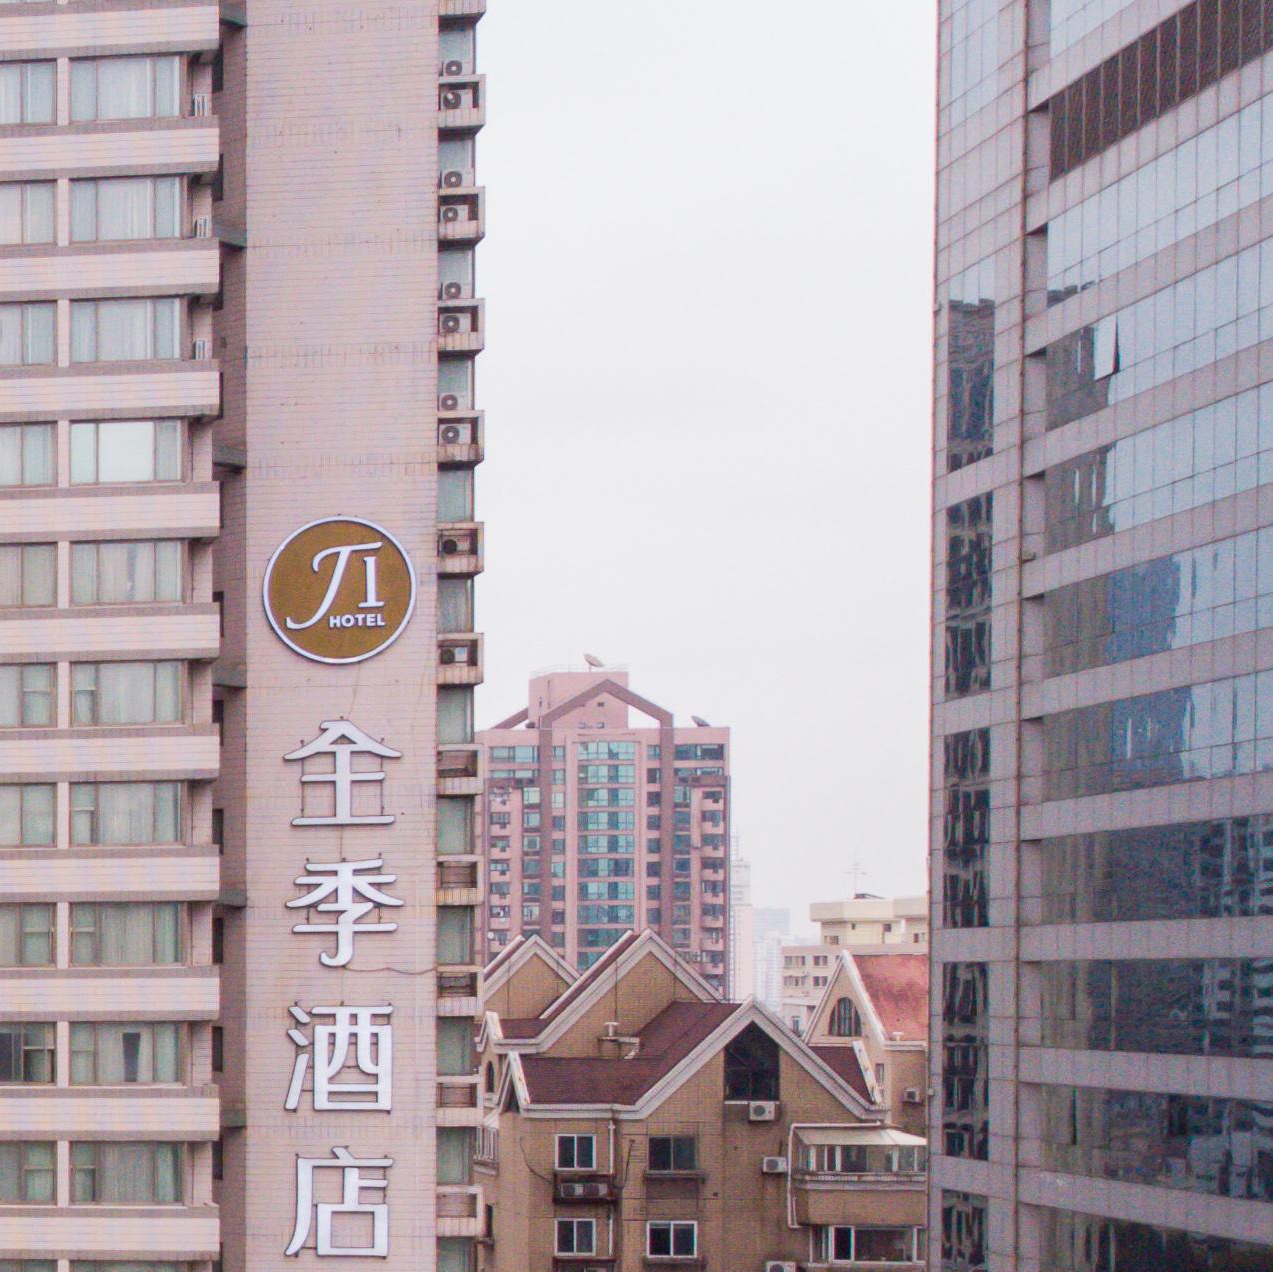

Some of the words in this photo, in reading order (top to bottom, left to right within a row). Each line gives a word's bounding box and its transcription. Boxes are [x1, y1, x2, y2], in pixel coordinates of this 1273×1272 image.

[327, 611, 386, 629] HOTEL
[283, 718, 405, 1261] 全季酒店
